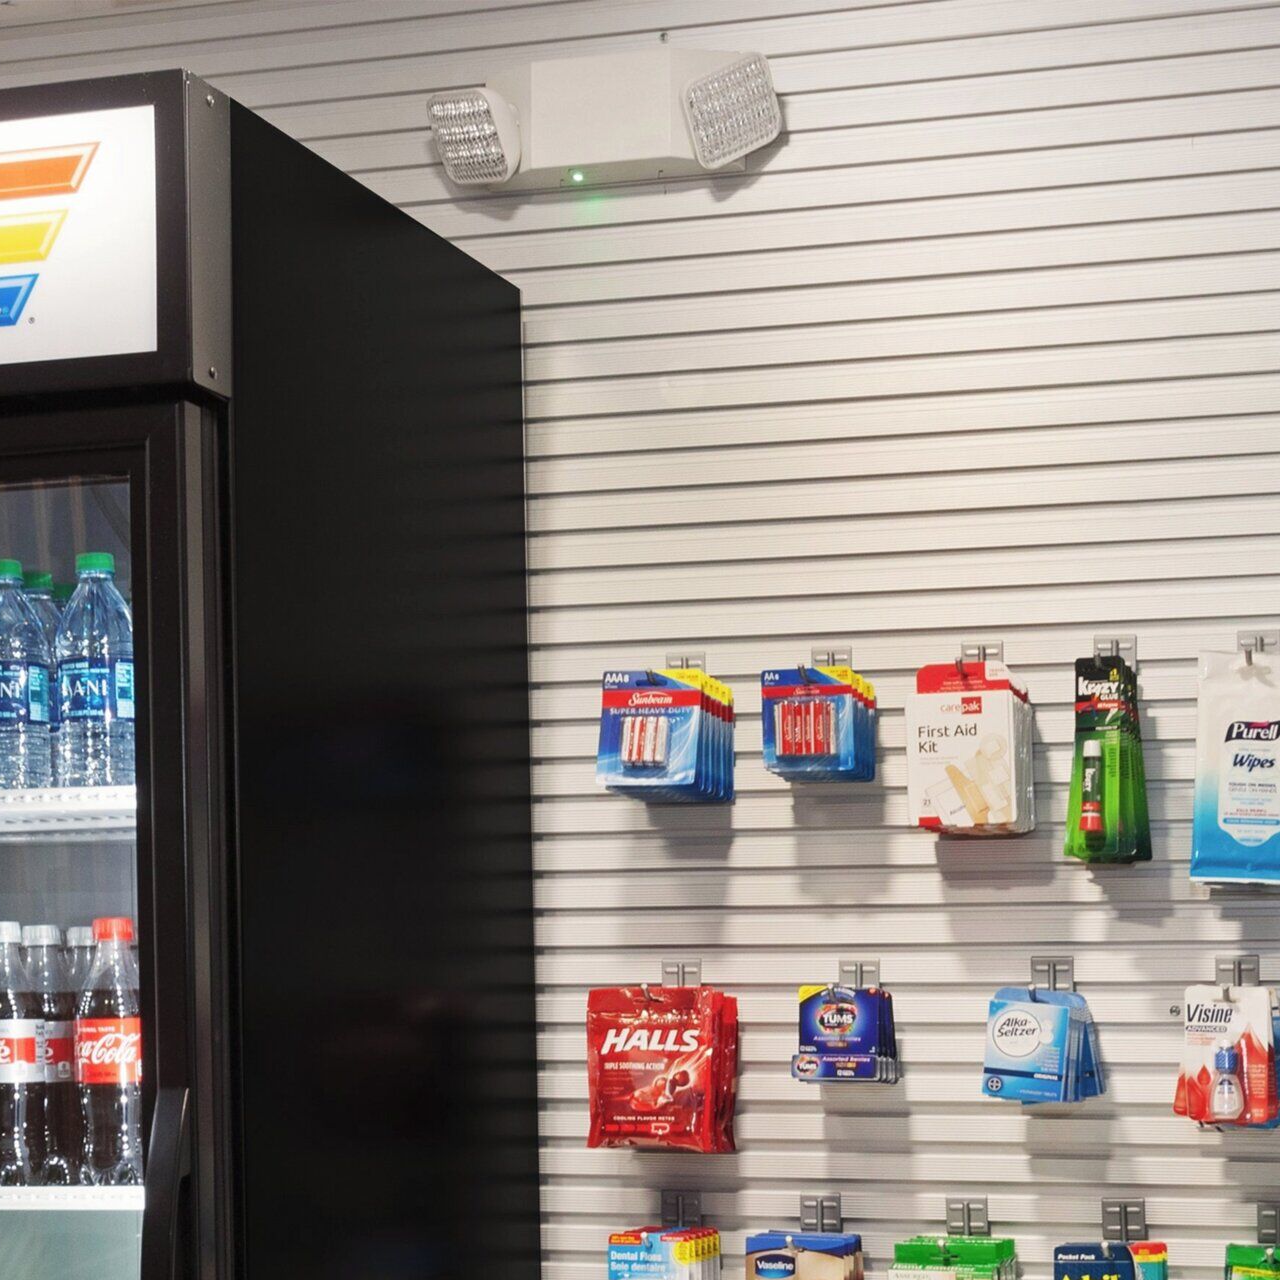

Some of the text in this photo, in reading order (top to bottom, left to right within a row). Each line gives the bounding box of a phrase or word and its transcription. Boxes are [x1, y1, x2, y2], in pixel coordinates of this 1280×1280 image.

[605, 673, 624, 683] AAA
[764, 671, 775, 681] AA
[628, 691, 673, 706] Sunbeam
[610, 705, 691, 715] SUPER HEAVY DUTY
[940, 699, 981, 714] carepak
[918, 723, 978, 739] First Aid
[1231, 722, 1280, 740] Purell
[918, 741, 939, 754] Kit
[1233, 753, 1276, 773] Wipes
[823, 1012, 854, 1025] TUMS
[1186, 1003, 1234, 1024] Visine
[1001, 1018, 1032, 1028] Alka-
[996, 1027, 1038, 1039] Seltzer
[601, 1028, 700, 1055] HALLS
[610, 1250, 637, 1261] Dental
[756, 1260, 795, 1271] Vaseline
